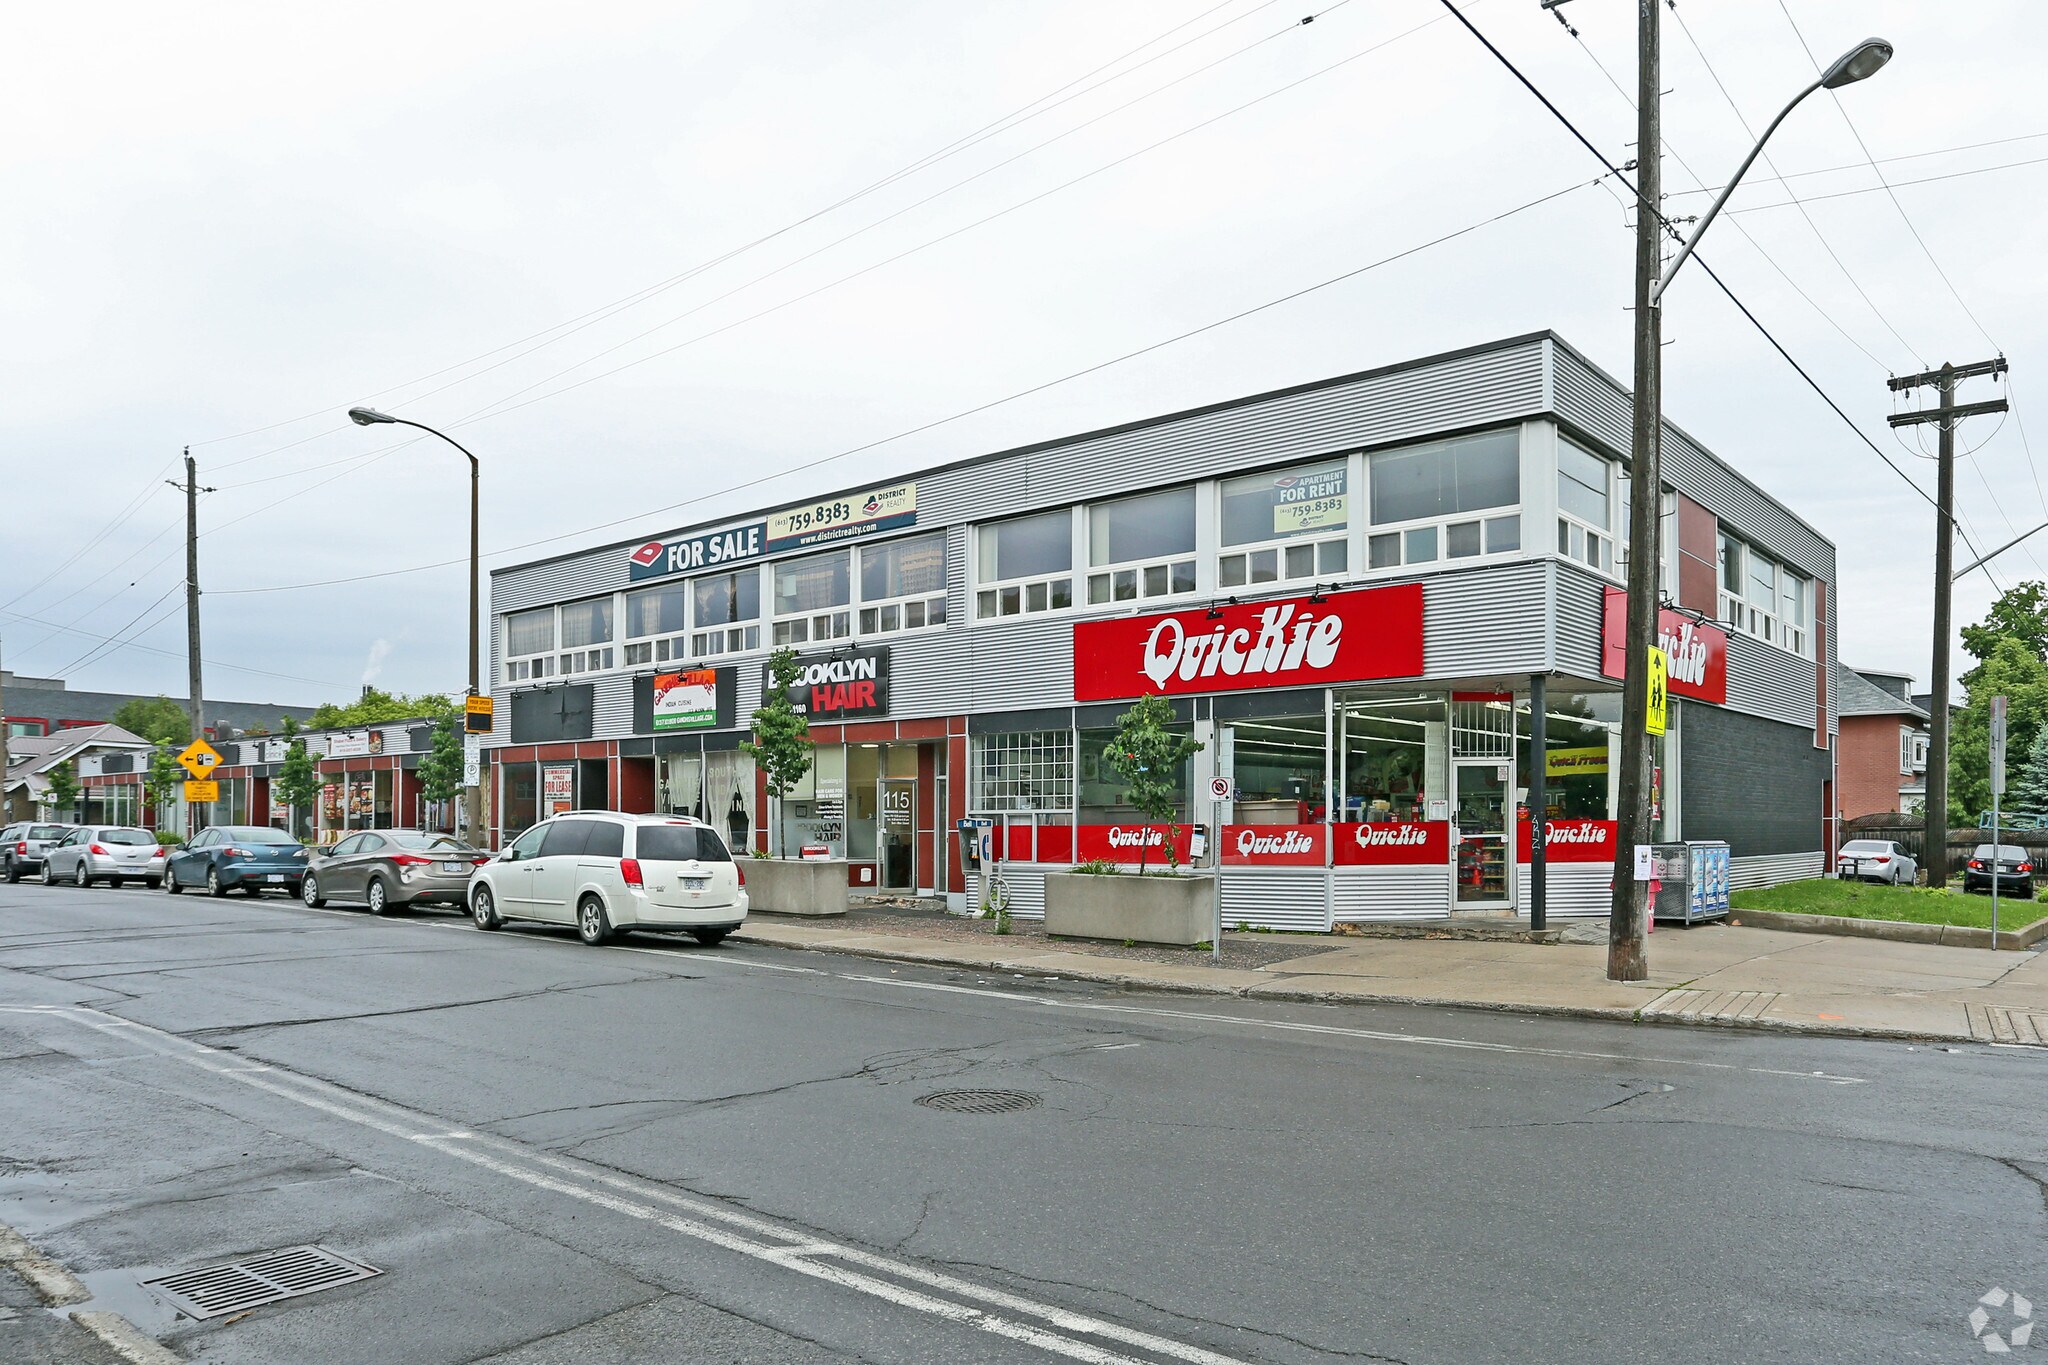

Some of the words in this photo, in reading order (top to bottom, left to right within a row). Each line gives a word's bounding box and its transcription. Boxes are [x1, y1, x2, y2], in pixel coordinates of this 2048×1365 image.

[1299, 471, 1344, 486] APARTMENT
[878, 488, 906, 501] DISTRICT
[1280, 488, 1306, 503] FOR
[1309, 480, 1343, 499] RENT
[886, 497, 906, 509] REALTY
[1292, 499, 1342, 517] 759.8383
[789, 502, 850, 532] 759.8383
[800, 522, 877, 545] www.districtrealty.com
[667, 540, 704, 572] FOR
[708, 527, 759, 563] SALE
[811, 680, 877, 713] HAIR
[556, 781, 572, 793] LEASE
[884, 791, 910, 808] 115
